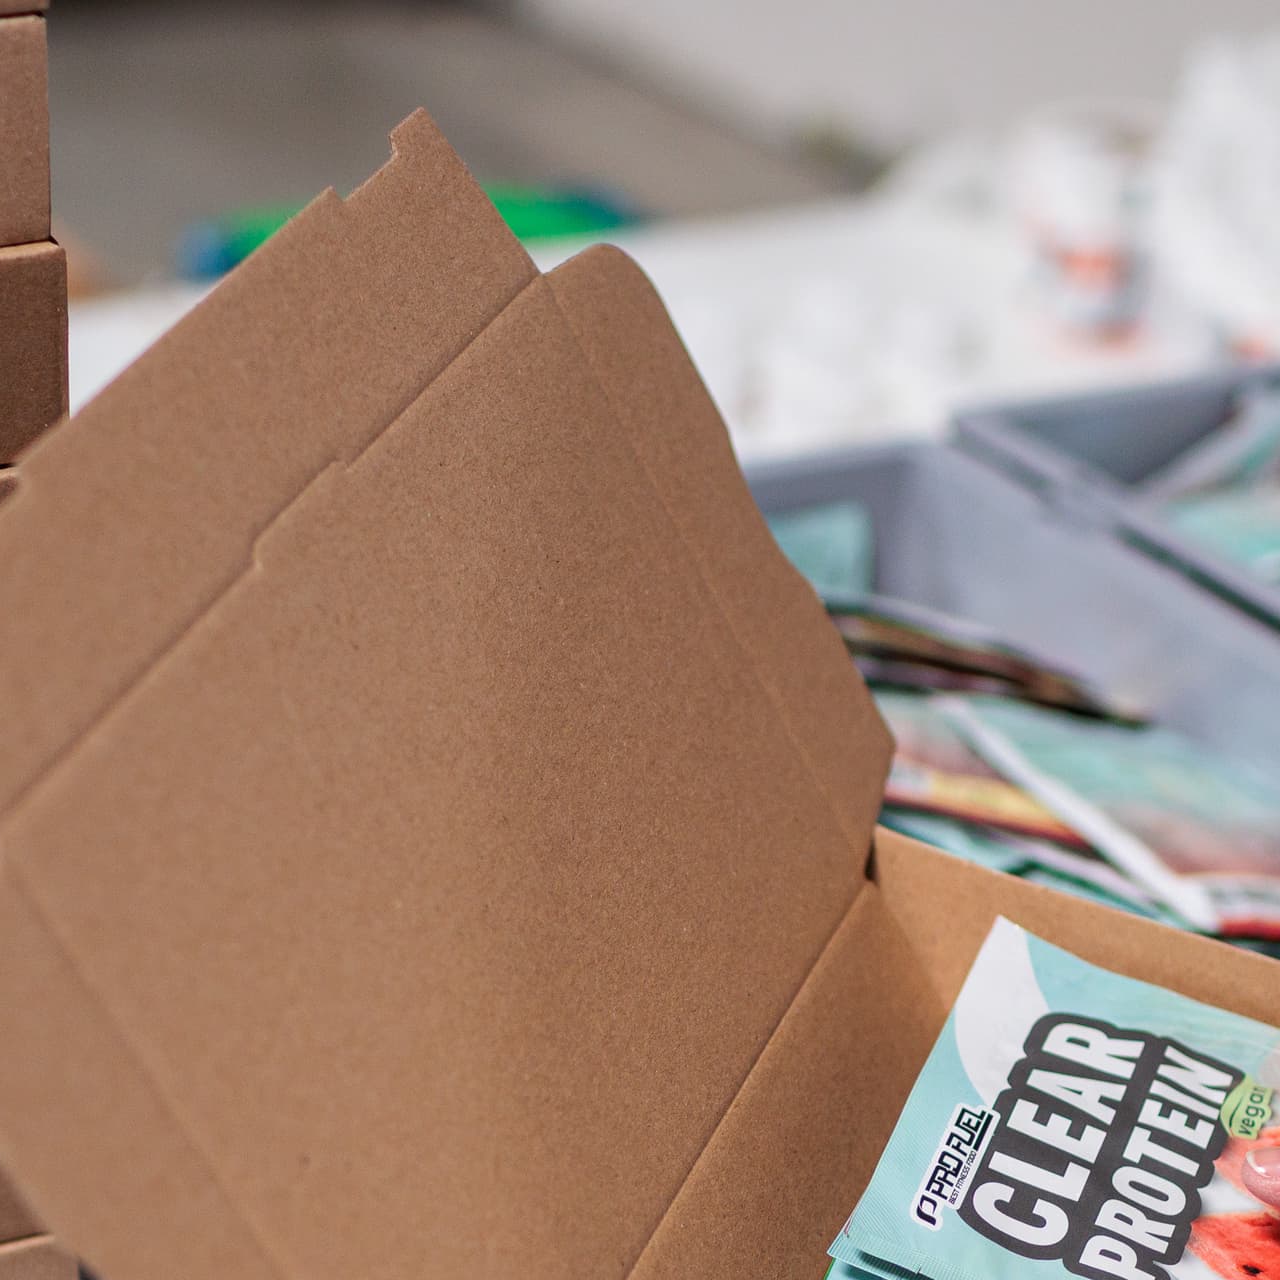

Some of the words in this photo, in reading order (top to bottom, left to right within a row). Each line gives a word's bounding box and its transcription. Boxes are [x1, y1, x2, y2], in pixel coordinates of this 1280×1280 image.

[925, 1150, 964, 1201] PRO
[945, 1107, 987, 1157] FUEL
[948, 1189, 959, 1205] BEST
[955, 1165, 971, 1190] FITNESS
[967, 1151, 978, 1167] FOOD
[973, 1022, 1146, 1247] CLEAR
